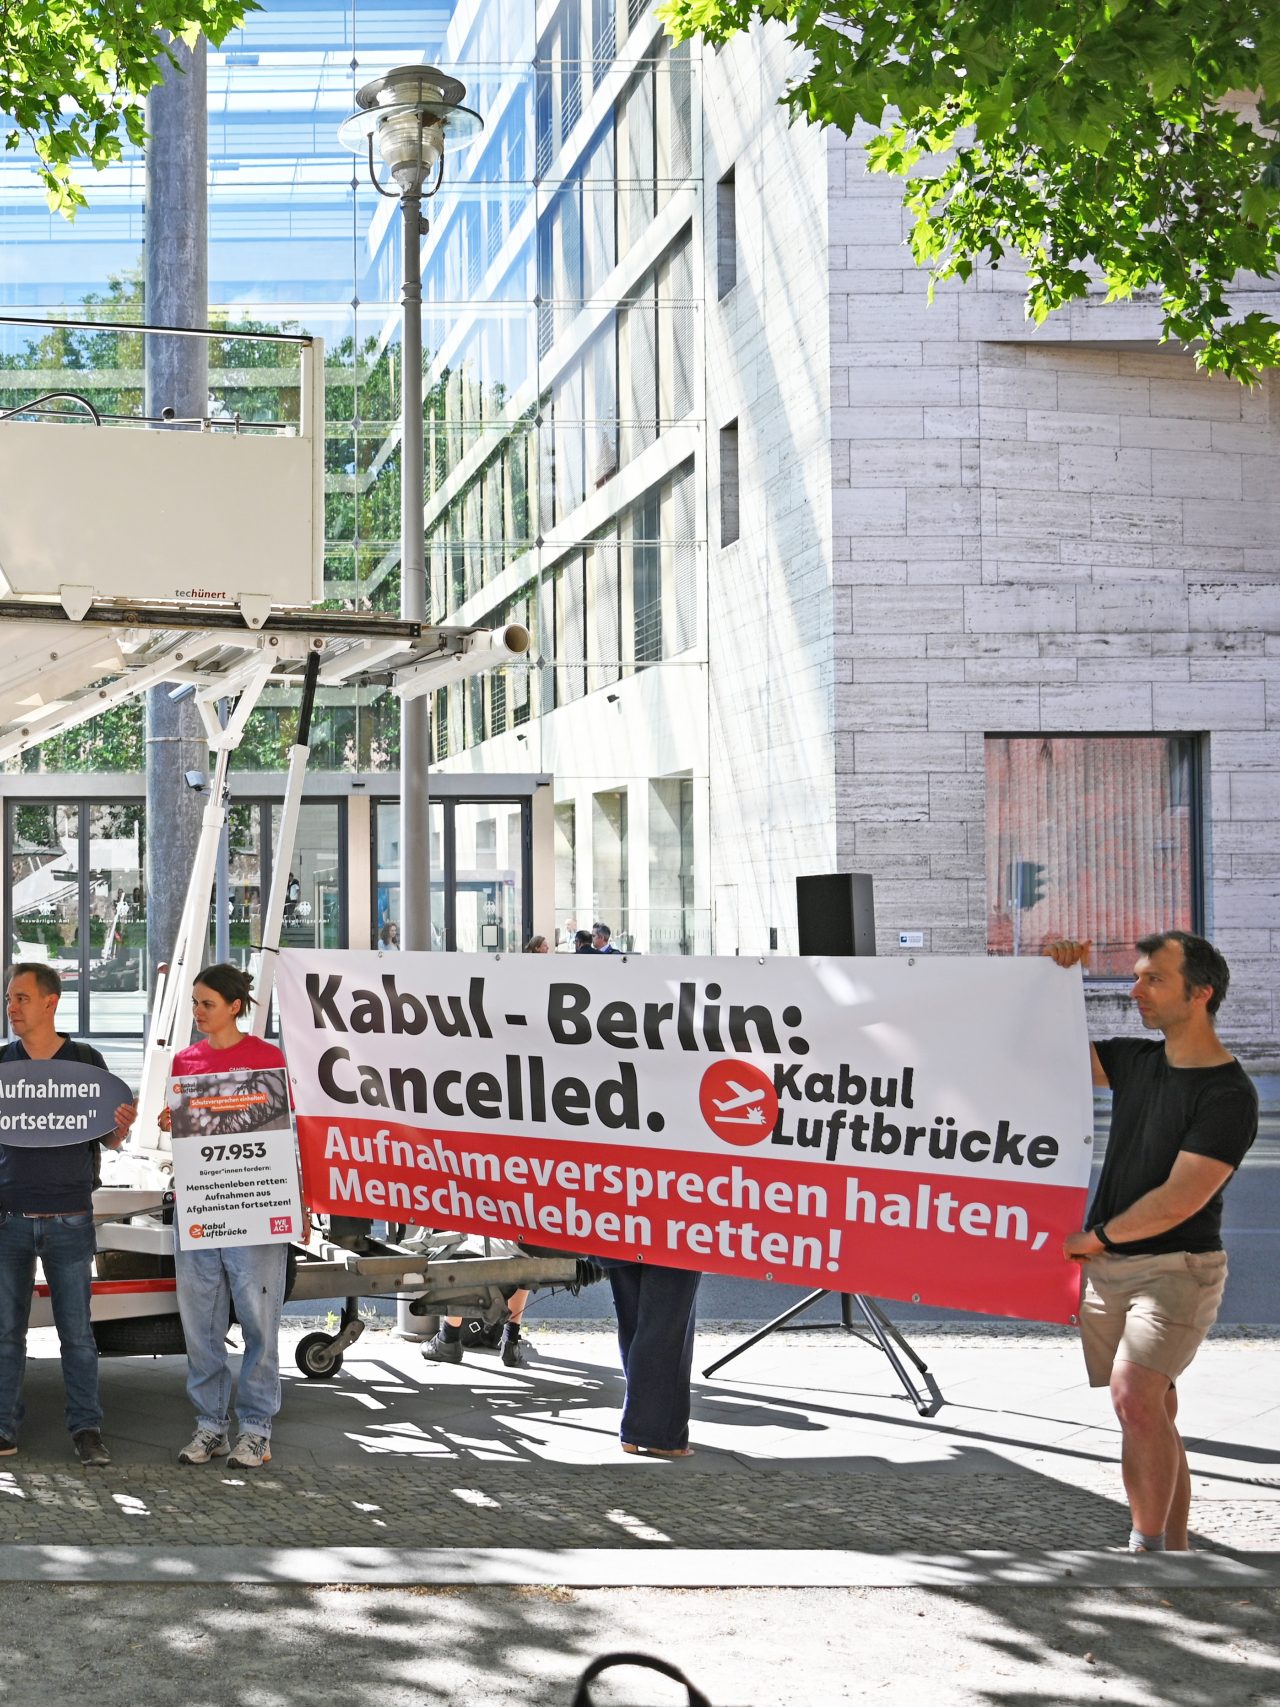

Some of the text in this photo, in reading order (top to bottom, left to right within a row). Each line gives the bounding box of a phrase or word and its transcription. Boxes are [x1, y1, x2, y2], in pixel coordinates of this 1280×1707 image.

[175, 589, 227, 600] techünert
[305, 972, 810, 1056] Kabul - Berlin:
[318, 1045, 666, 1134] Cancelled.
[773, 1063, 915, 1109] Kabul
[771, 1107, 1060, 1169] Luftbrücke
[200, 1142, 267, 1163] 97.953
[186, 1177, 288, 1192] Menschenleben retten:
[324, 1125, 1051, 1251] Aufnahmeversprechen halten,
[205, 1189, 271, 1202] Aufnahmen aus
[186, 1198, 292, 1215] Afghanistan fortsetzen!
[201, 1221, 226, 1231] Kabul
[274, 1218, 287, 1226] WE
[328, 1166, 842, 1272] Menschenleben retten!
[201, 1227, 248, 1239] Luftbrücke
[273, 1224, 289, 1233] ACT
